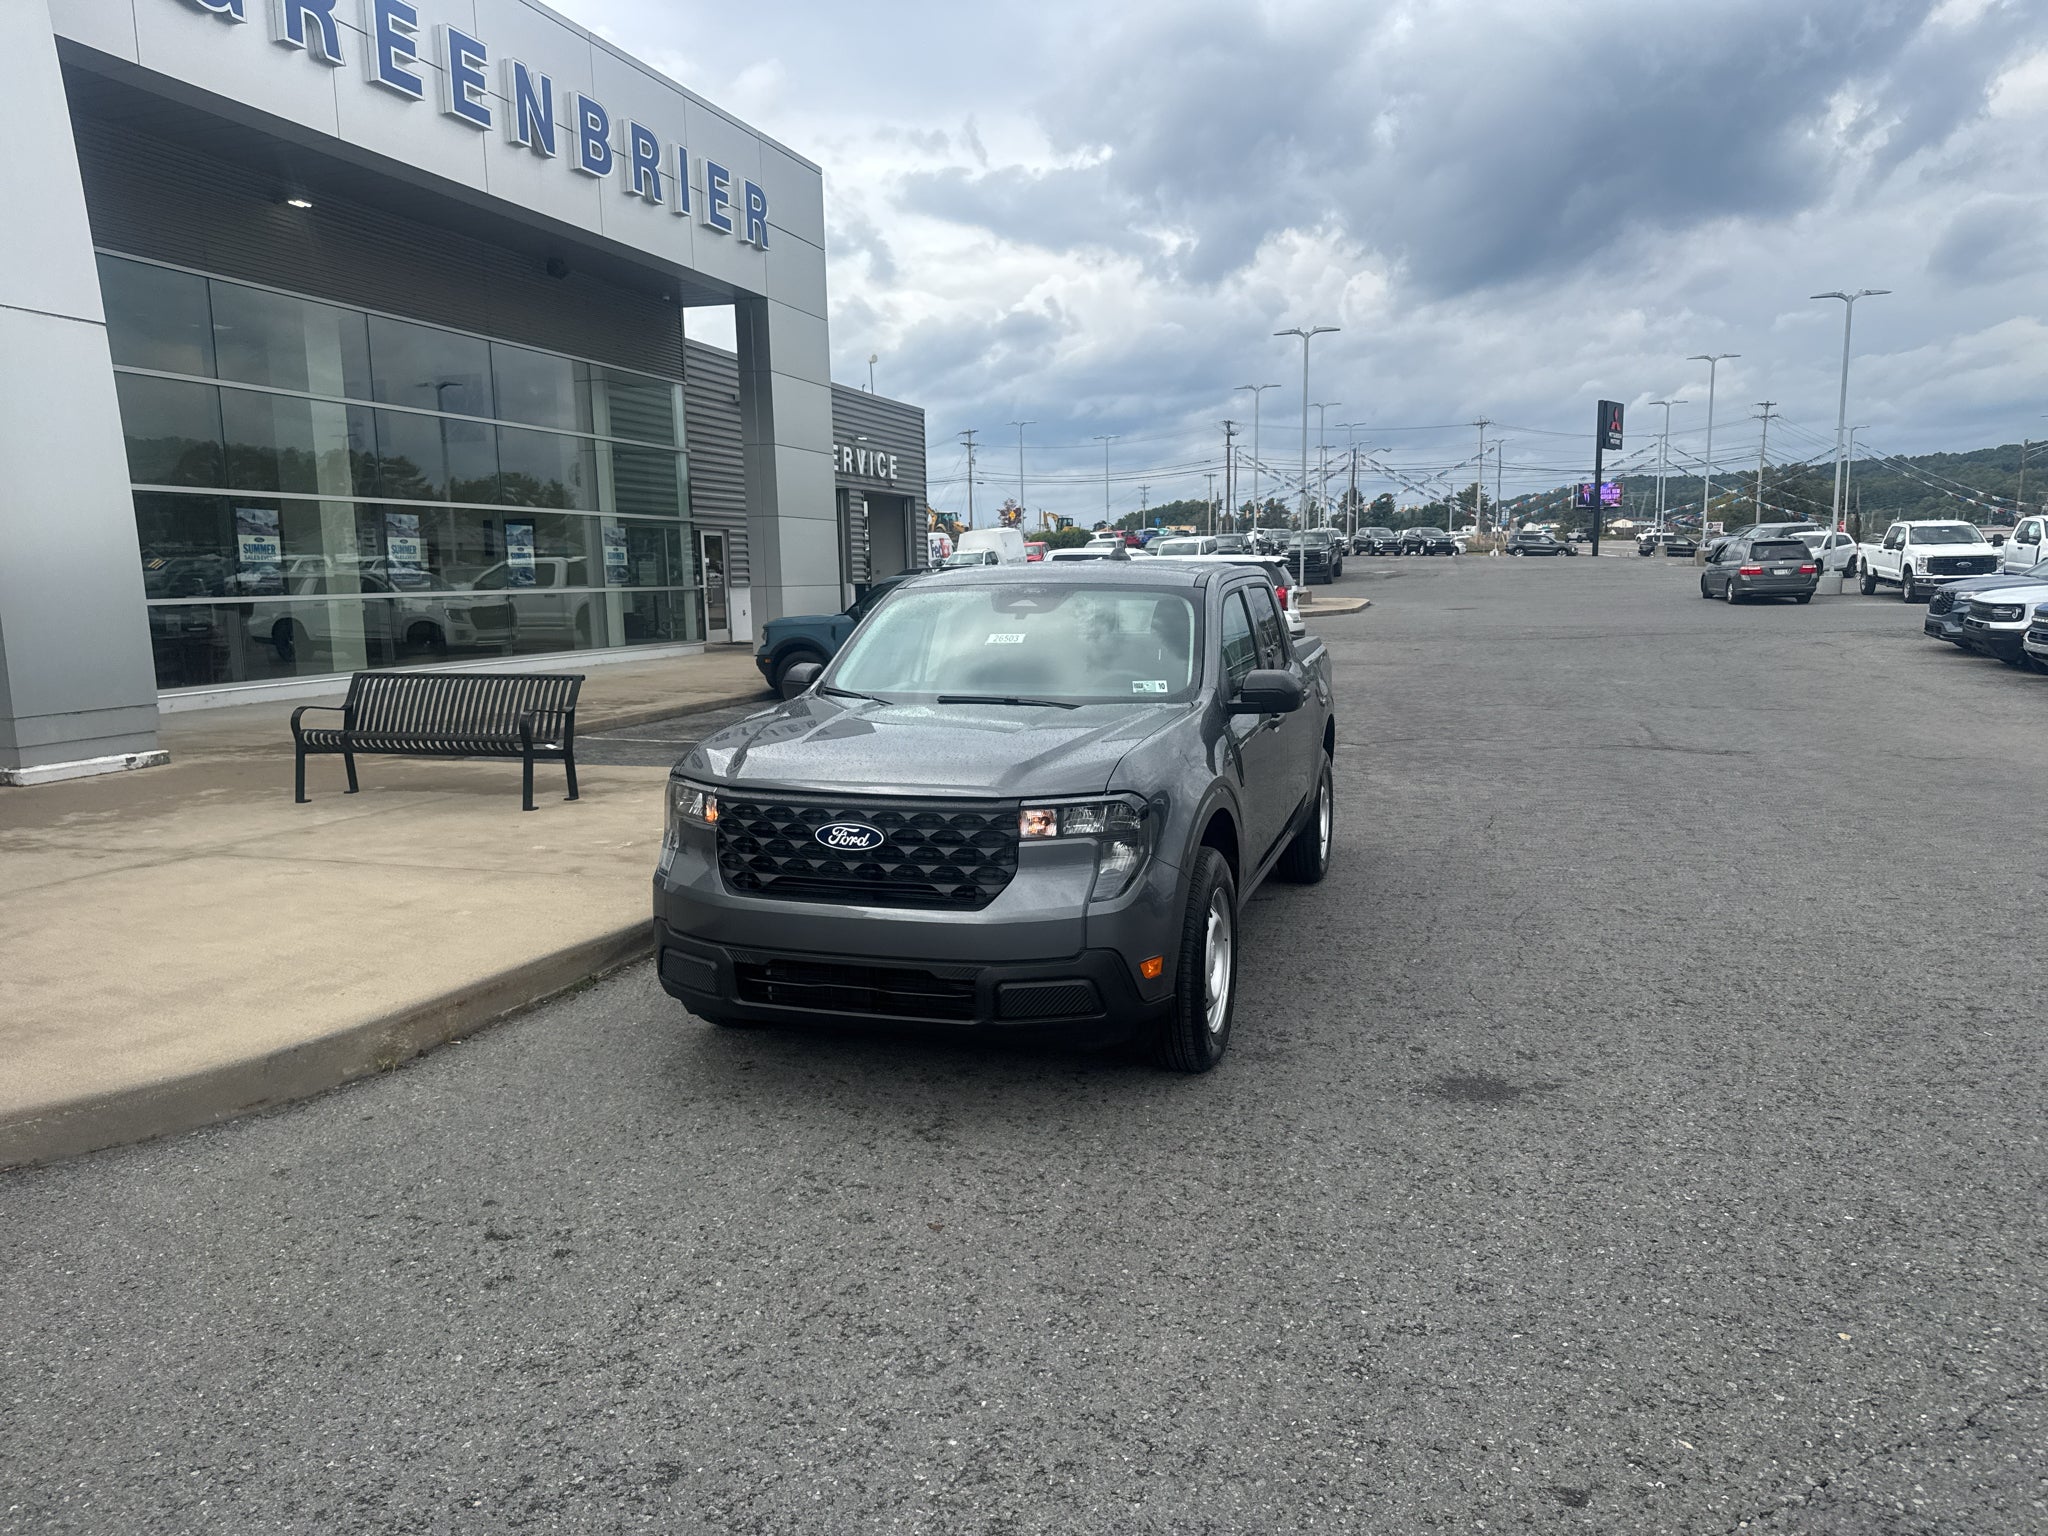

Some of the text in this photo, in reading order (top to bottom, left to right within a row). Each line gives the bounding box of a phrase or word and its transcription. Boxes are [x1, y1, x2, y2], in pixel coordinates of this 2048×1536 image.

[197, 0, 770, 251] REENBRIER
[833, 444, 898, 480] ERVICE
[242, 543, 276, 555] SUMMER
[391, 544, 417, 555] SUMMER
[993, 634, 1020, 643] 26503
[828, 826, 871, 847] Ford
